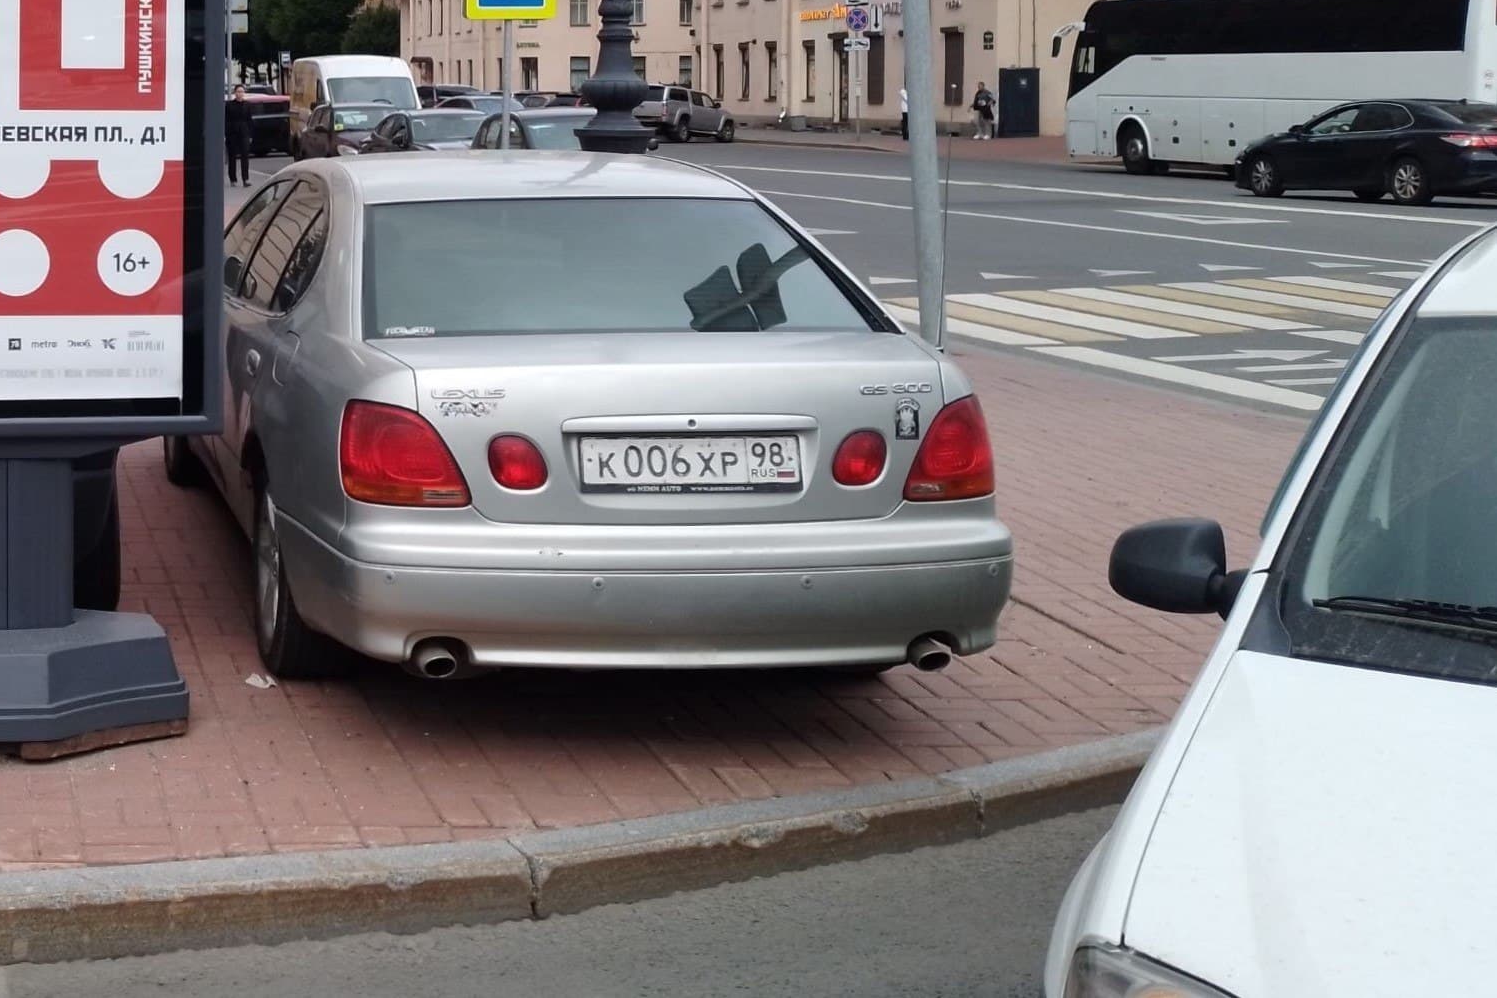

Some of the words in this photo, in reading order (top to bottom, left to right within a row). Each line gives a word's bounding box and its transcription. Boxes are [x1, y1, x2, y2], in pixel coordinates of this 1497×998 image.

[112, 252, 151, 273] 16+
[31, 339, 58, 349] metro
[431, 388, 506, 400] LEXUS
[859, 384, 888, 396] GS
[892, 382, 932, 394] 300
[751, 441, 786, 468] 98
[751, 468, 776, 478] RUS
